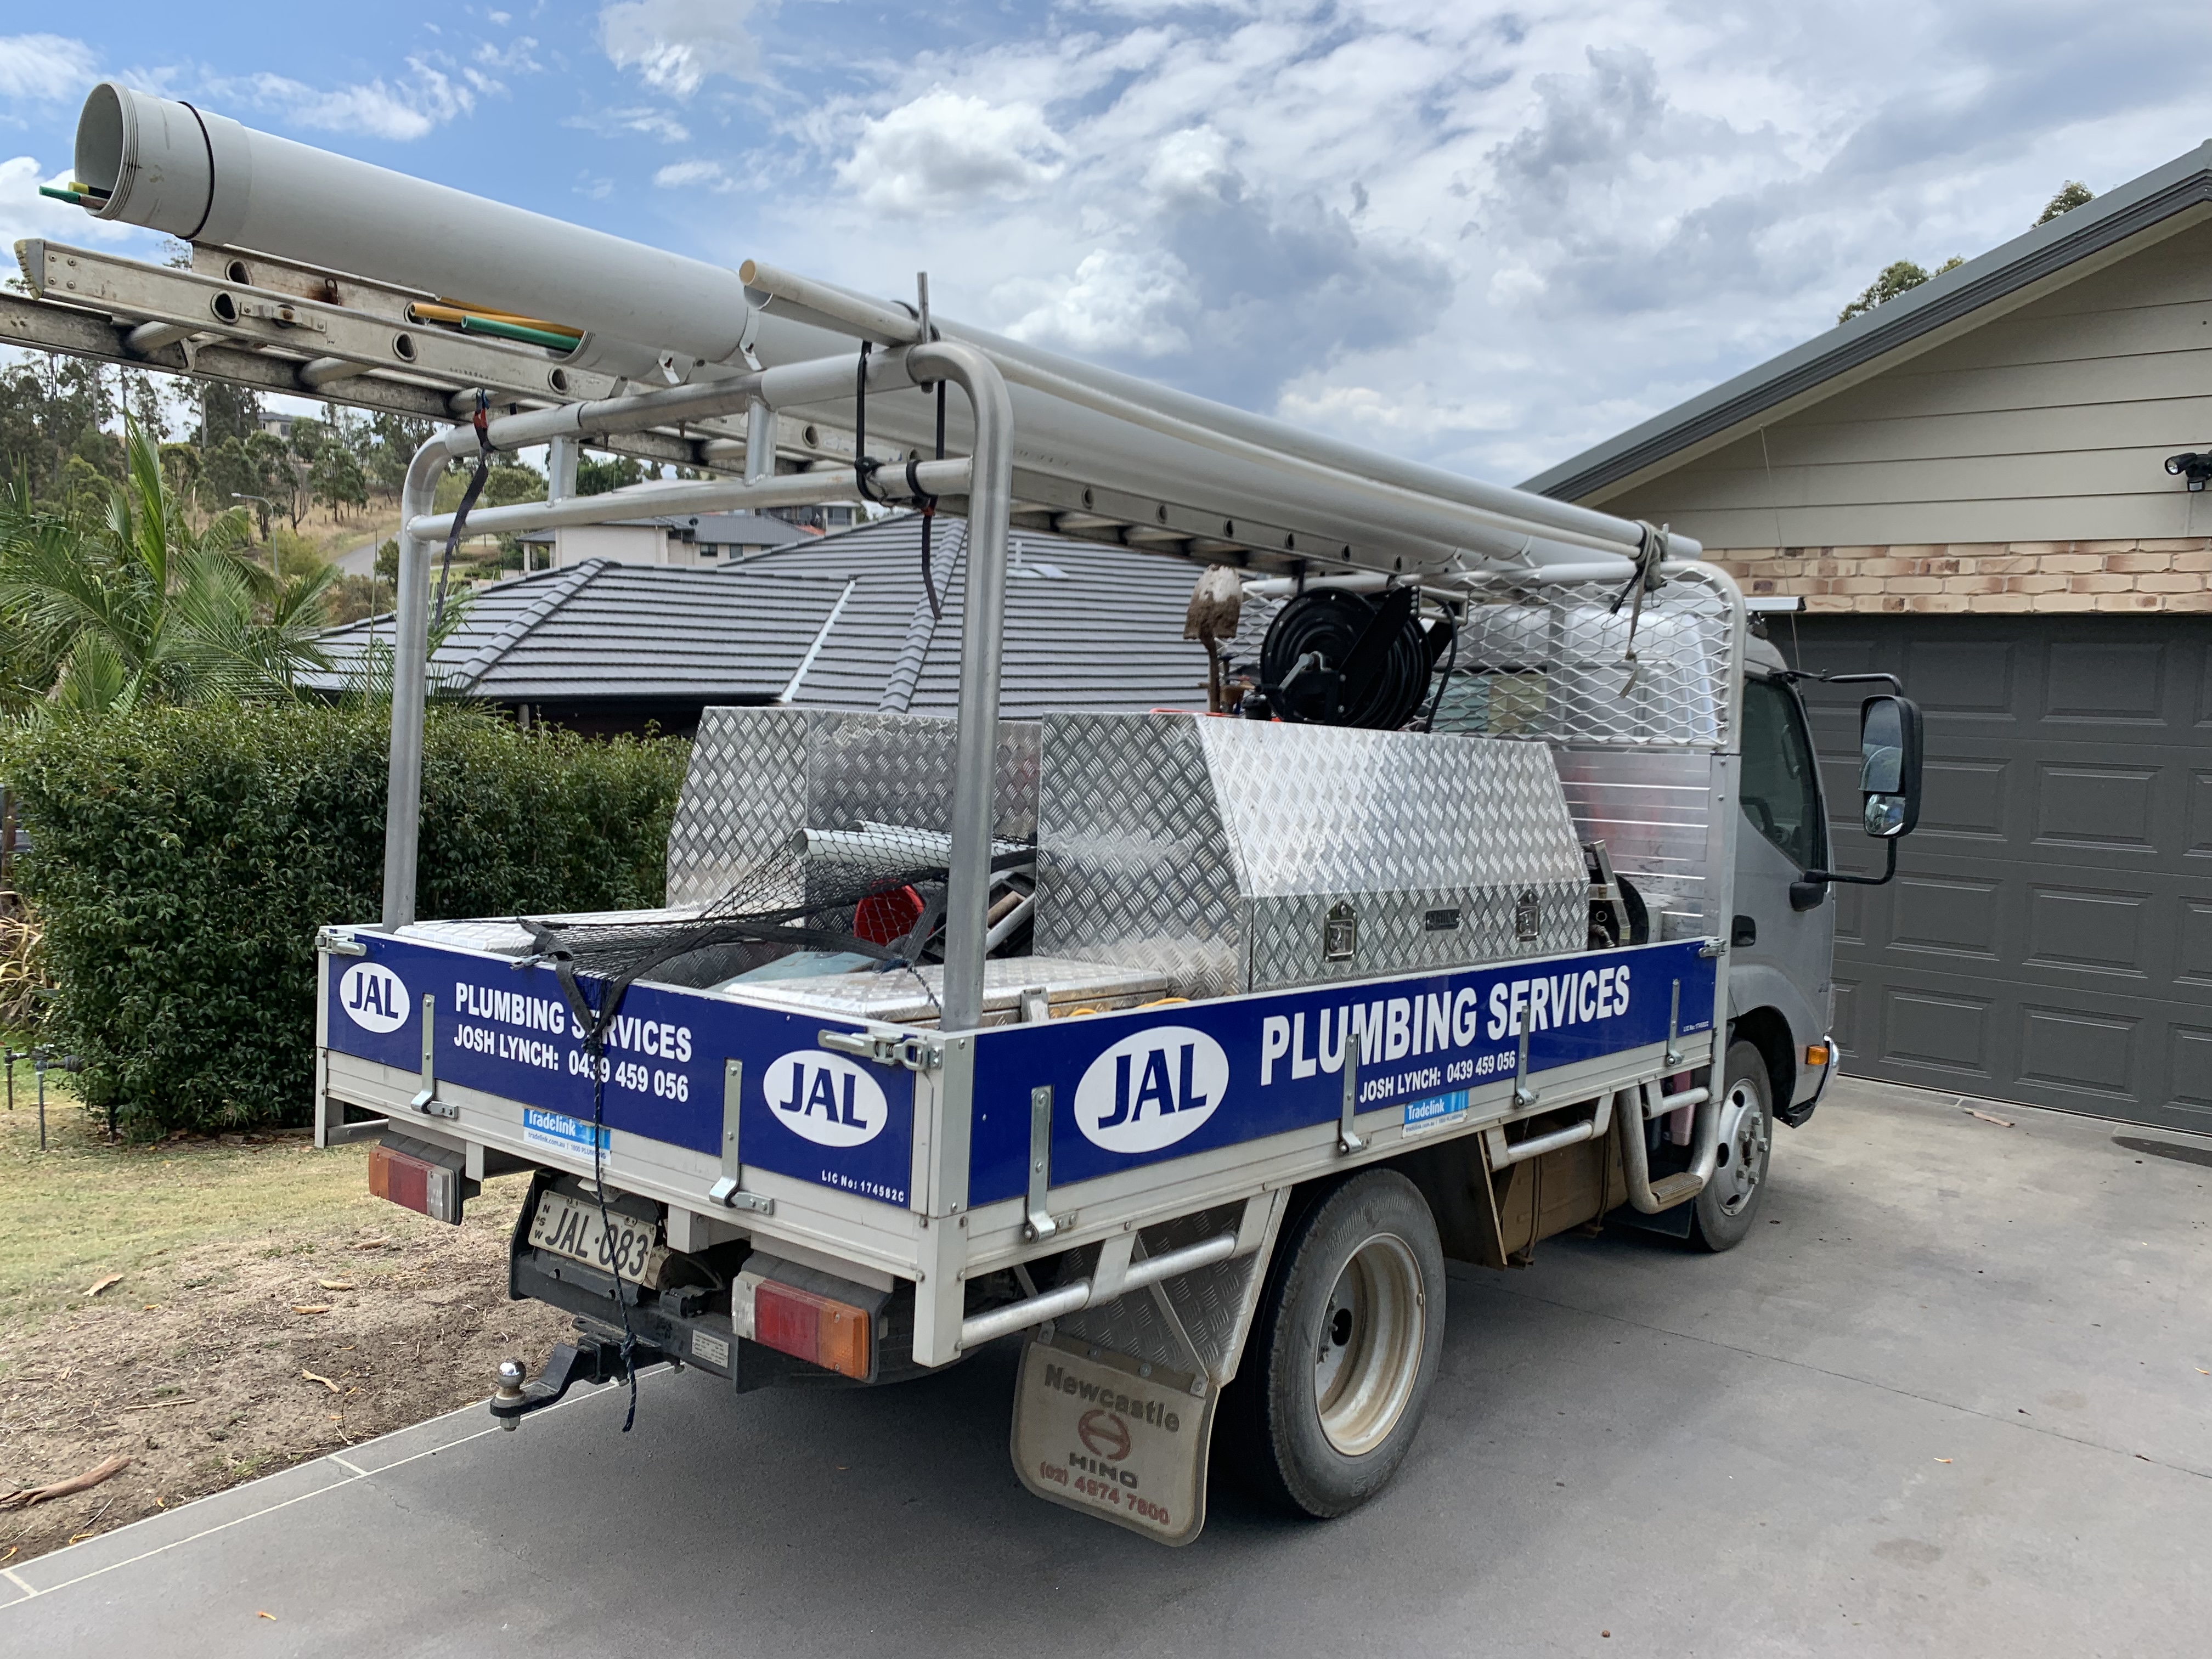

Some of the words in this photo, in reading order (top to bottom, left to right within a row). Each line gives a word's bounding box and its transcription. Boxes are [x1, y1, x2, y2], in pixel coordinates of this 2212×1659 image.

[349, 971, 399, 1019] JAL
[455, 981, 565, 1035] PLUMBING
[571, 1008, 692, 1063] SRVICES
[1261, 987, 1477, 1086] PLUMBING
[1487, 964, 1630, 1041] SERVICES
[453, 1024, 495, 1055] JOSH
[499, 1033, 559, 1071] LYNCH:
[614, 1061, 649, 1093] 459
[653, 1069, 689, 1103] 056
[1097, 1043, 1207, 1130] JAL
[1359, 1076, 1394, 1103] JOSH
[1397, 1066, 1441, 1095] LYNCH:
[1447, 1059, 1473, 1084] 0439
[1475, 1053, 1495, 1076] 459
[1497, 1050, 1516, 1071] 056
[779, 1062, 868, 1130] JAL
[1408, 1098, 1445, 1120] Tradelink
[528, 1109, 576, 1137] Tradelink
[528, 1131, 566, 1148] tradelink.com.au
[571, 1144, 581, 1153] 1800
[581, 1147, 606, 1159] PLUMNG
[821, 1169, 838, 1184] LIC
[840, 1175, 857, 1190] No:
[860, 1180, 905, 1203] 174582C
[1044, 1363, 1180, 1433] Newcastle
[1069, 1452, 1139, 1489] HINO
